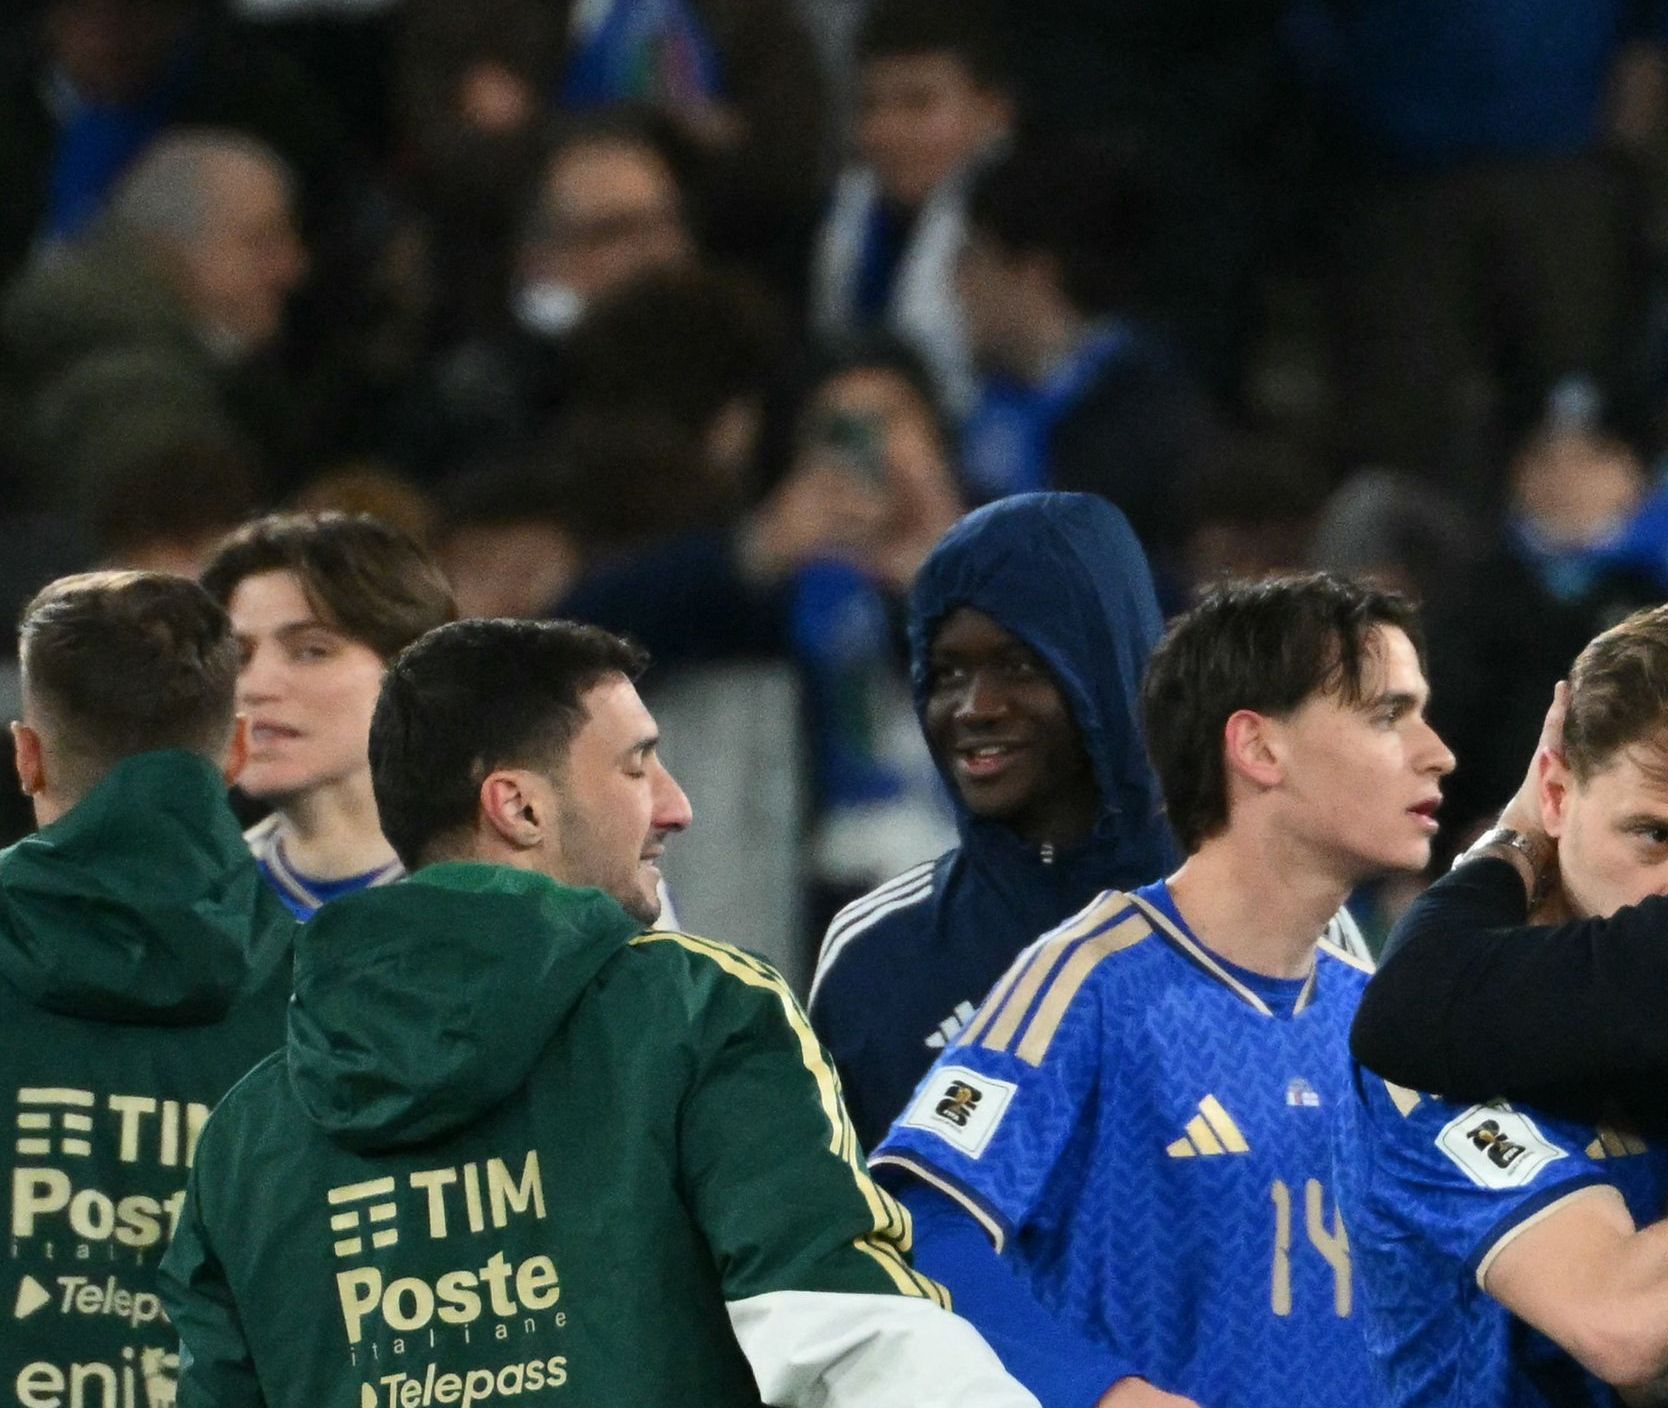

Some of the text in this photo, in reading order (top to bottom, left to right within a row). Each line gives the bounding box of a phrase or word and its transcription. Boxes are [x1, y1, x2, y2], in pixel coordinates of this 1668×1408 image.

[11, 1166, 187, 1248] Post
[410, 1149, 547, 1239] TIM
[1271, 1178, 1353, 1318] 14
[56, 1274, 173, 1329] Telep
[336, 1251, 561, 1345] Poste
[350, 1311, 567, 1367] italiane
